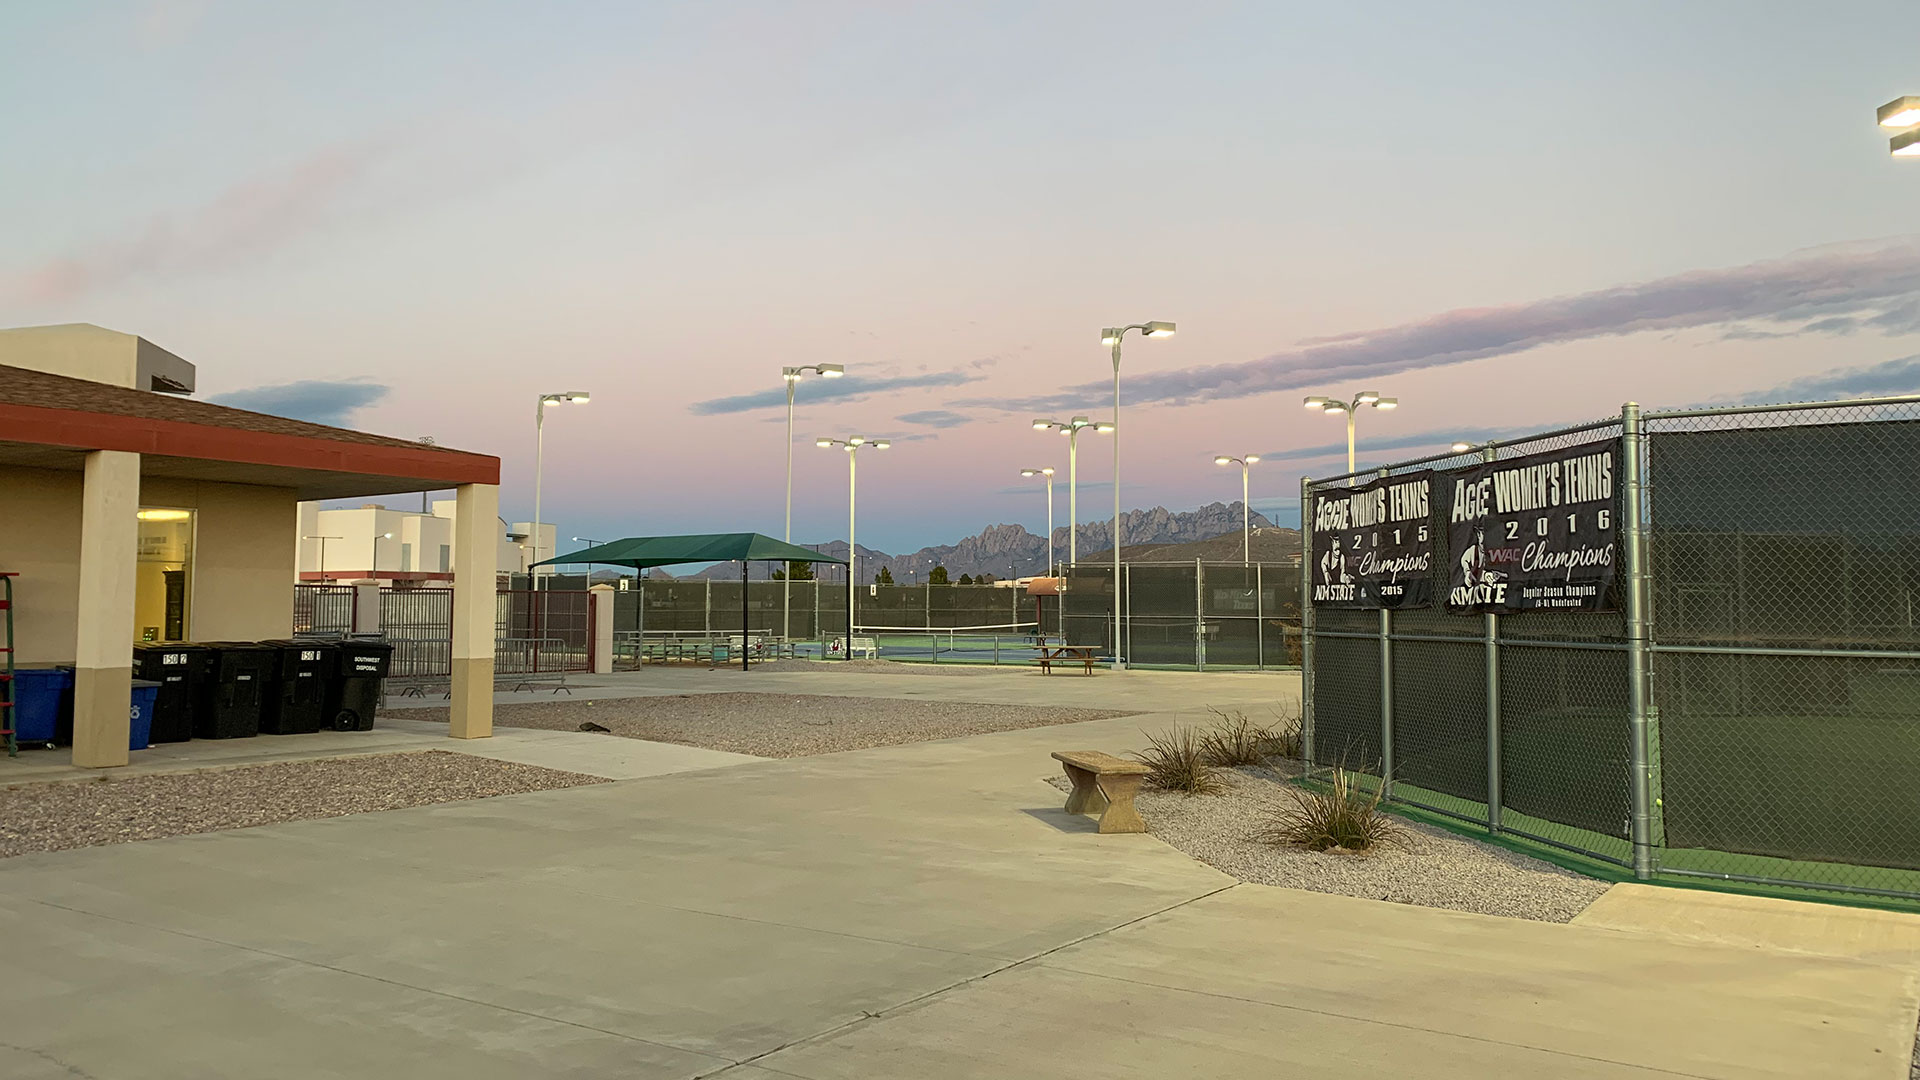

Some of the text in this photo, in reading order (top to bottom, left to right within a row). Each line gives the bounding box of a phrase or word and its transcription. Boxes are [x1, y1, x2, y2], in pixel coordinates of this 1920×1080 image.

[1493, 462, 1561, 513] WOMEN'S
[1564, 451, 1612, 504] TENNIS
[1315, 496, 1350, 532] AGGIE
[1388, 479, 1429, 522] TENNIS
[1359, 551, 1430, 584] Champions
[1488, 540, 1613, 582] WAC Champions
[1381, 586, 1403, 595] 2015
[1565, 584, 1596, 597] Champions
[163, 654, 187, 664] 150 2
[301, 651, 315, 660] 150
